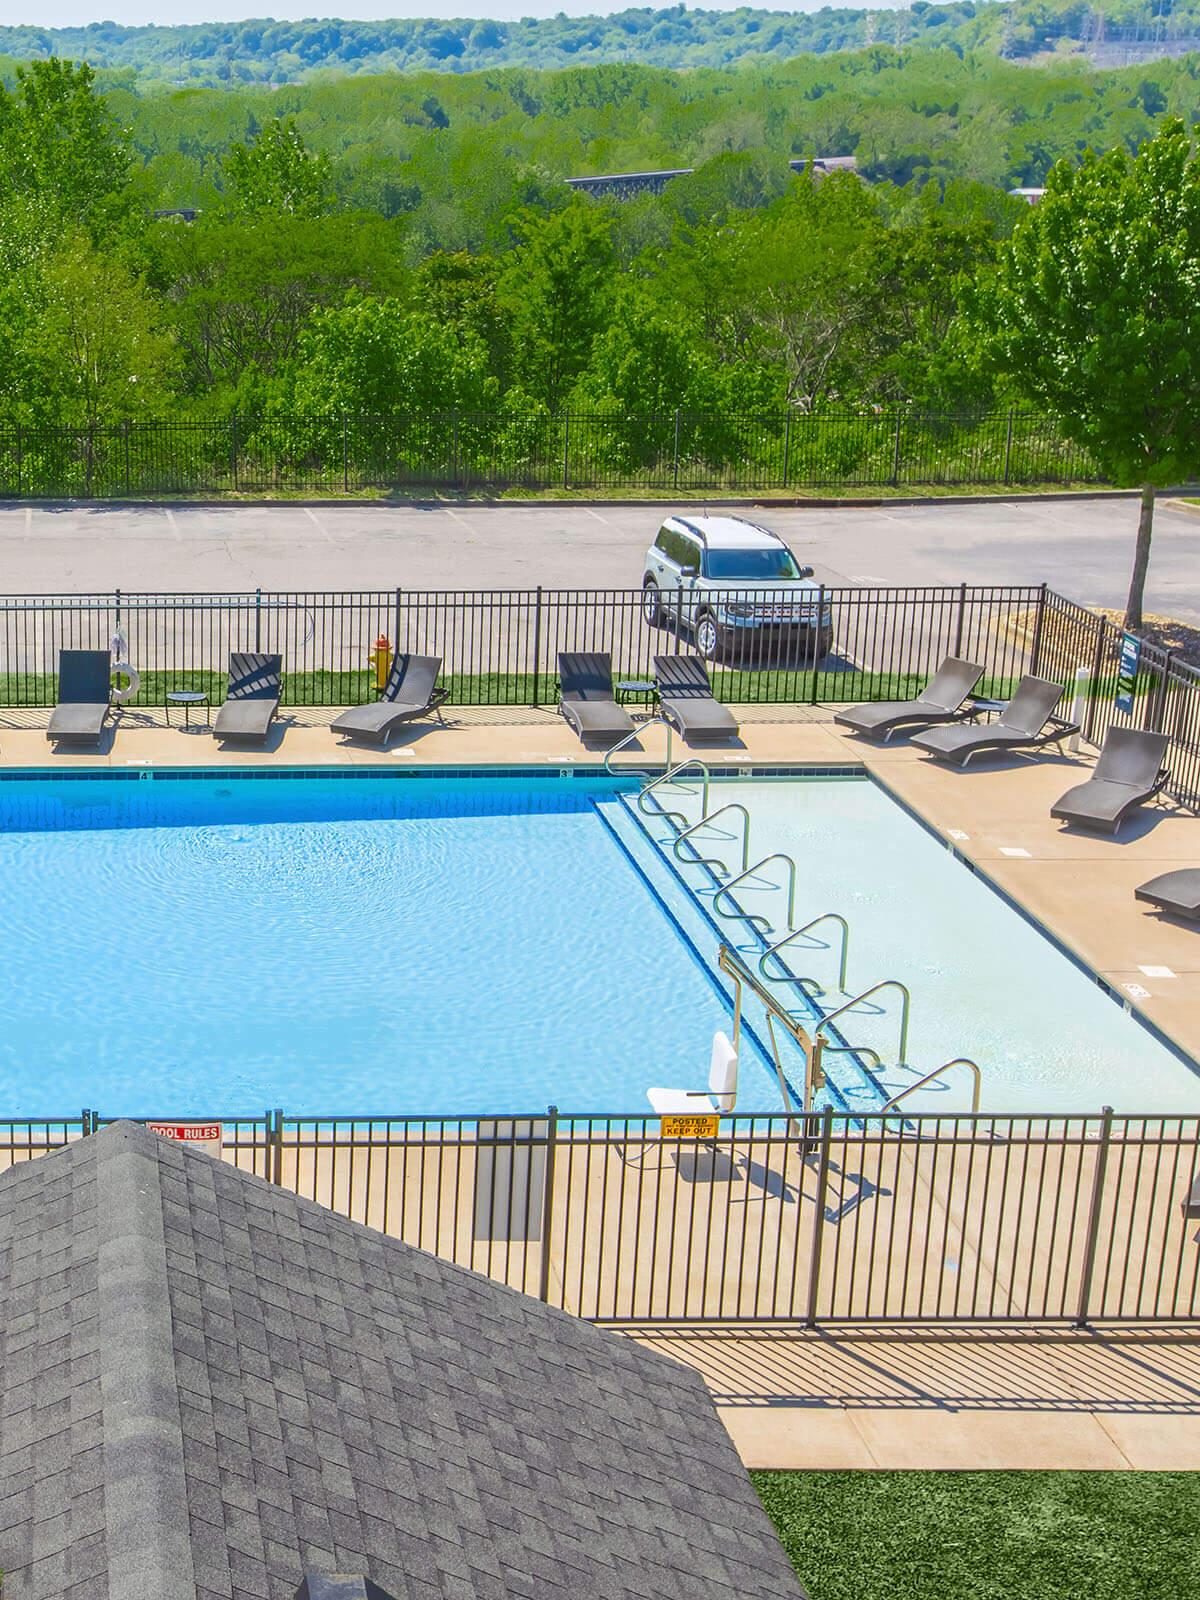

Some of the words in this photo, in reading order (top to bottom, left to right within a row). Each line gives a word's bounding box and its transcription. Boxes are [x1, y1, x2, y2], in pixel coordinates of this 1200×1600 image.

[184, 1127, 217, 1138] RULES
[666, 1127, 690, 1135] KEEP
[693, 1127, 711, 1135] OUT
